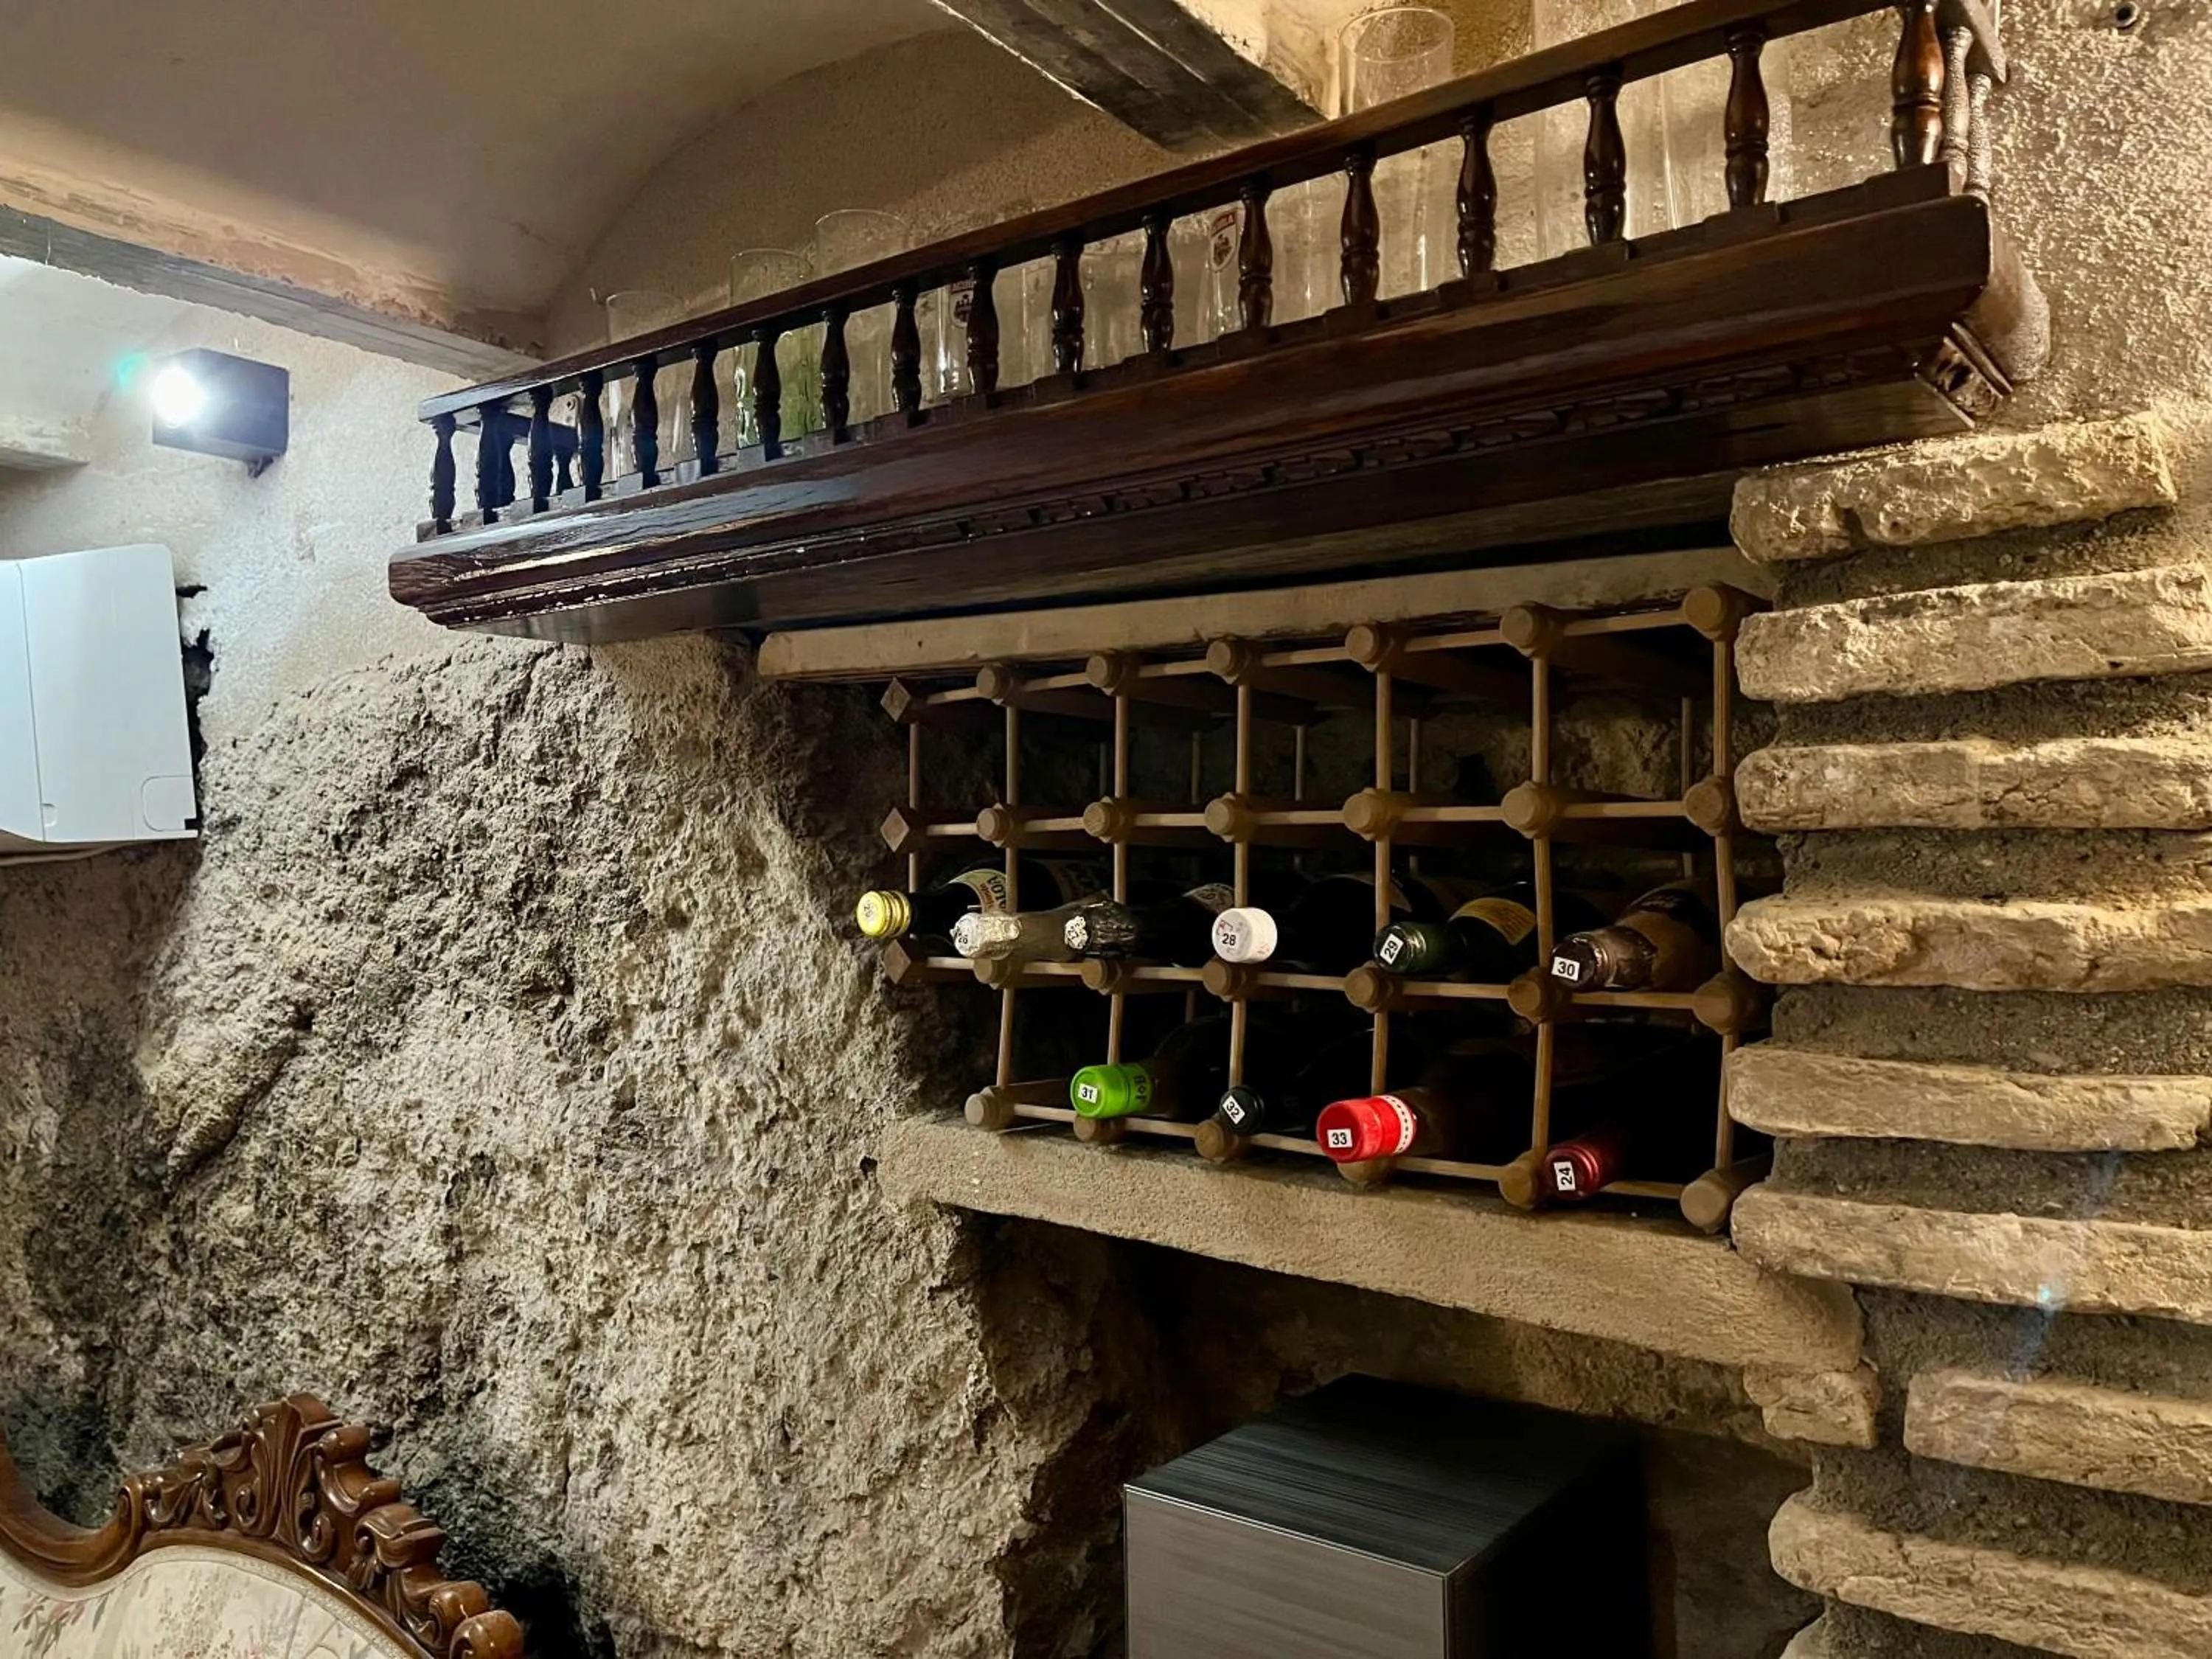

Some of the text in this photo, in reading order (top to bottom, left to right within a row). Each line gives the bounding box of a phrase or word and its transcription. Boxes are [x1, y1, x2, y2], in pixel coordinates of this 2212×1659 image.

[1222, 933, 1237, 946] 28
[1384, 940, 1399, 959] 29
[1557, 961, 1576, 977] 30
[1081, 1086, 1093, 1099] 31
[1226, 1101, 1240, 1119] 32
[1331, 1132, 1348, 1145] 33
[1559, 1167, 1573, 1185] 24
